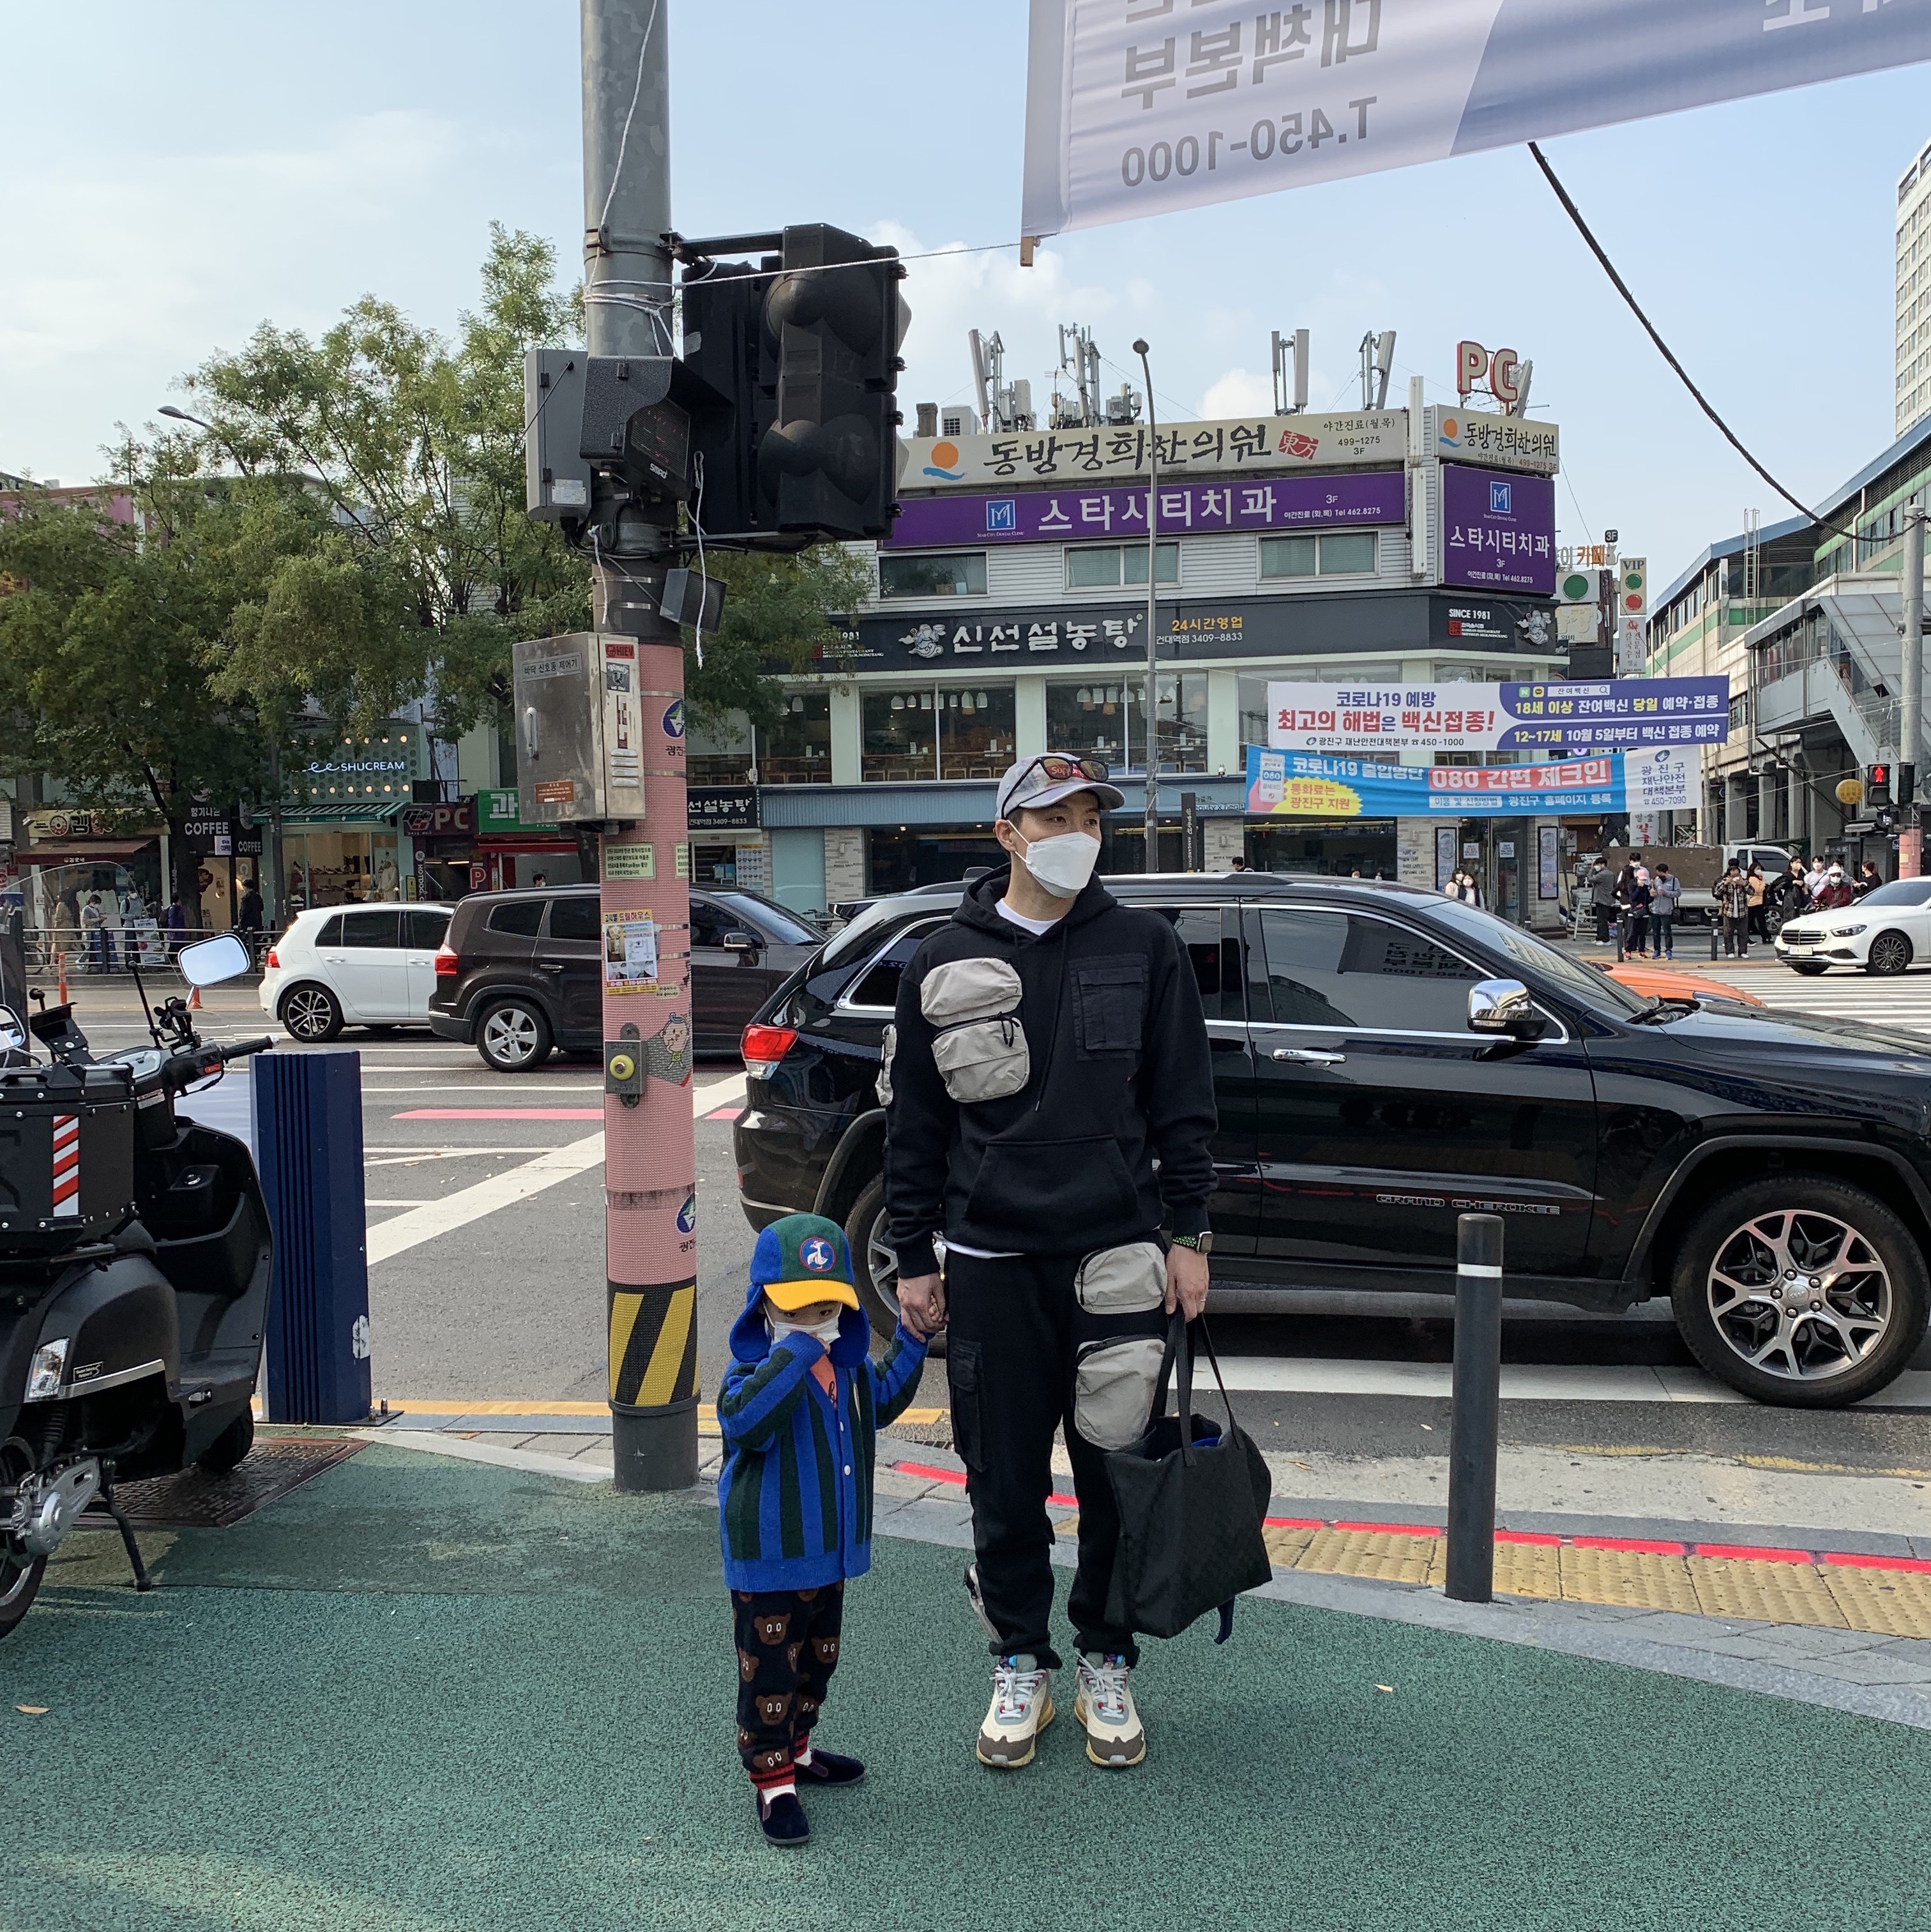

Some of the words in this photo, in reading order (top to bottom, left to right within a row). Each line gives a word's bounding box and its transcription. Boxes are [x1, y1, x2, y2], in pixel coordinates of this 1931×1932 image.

[1457, 340, 1518, 402] PC
[1338, 436, 1381, 446] 499-1275
[1464, 422, 1557, 459] 동방경희한의원
[984, 424, 1271, 476] 동방경희한의원
[1353, 447, 1365, 455] 3F
[1518, 459, 1547, 470] 499-1275
[1549, 462, 1557, 471] 3F
[1326, 494, 1338, 503] 3F
[1038, 486, 1276, 531] 스타시티치과
[1284, 511, 1310, 519] 야간진료
[1347, 507, 1381, 515] 462.8275
[1450, 526, 1550, 559] 스타시티치과
[1606, 531, 1617, 541] 3F
[1577, 545, 1605, 567] 카페
[1496, 558, 1505, 568] 3F
[1623, 560, 1644, 570] VIP
[1502, 574, 1510, 582] Tel
[1511, 575, 1533, 584] 462.8275
[1449, 609, 1471, 618] SINCE
[1473, 610, 1490, 620] 1981
[1172, 616, 1243, 632] 24시간영업
[953, 616, 1139, 653] 신선설농탕
[1156, 635, 1190, 645] 건대역점
[1192, 632, 1243, 643] 3409-8833
[524, 666, 536, 675] 바닥
[1558, 687, 1590, 695] 잔여백신
[1337, 692, 1401, 708] 코로나19
[1405, 692, 1437, 708] 예방
[1515, 701, 1543, 715] 18세
[1548, 701, 1573, 715] 이상
[1578, 699, 1629, 713] 잔여백신
[1633, 697, 1658, 711] 당일
[1278, 709, 1336, 732] 최고의
[1343, 710, 1397, 733] 해법은
[1401, 710, 1495, 733] 백신접종!
[1515, 729, 1562, 743] 12~17세
[1566, 729, 1593, 742] 10월
[1595, 727, 1638, 741] 5일부터
[1642, 726, 1665, 740] 백신
[1669, 724, 1692, 739] 접종
[1695, 723, 1720, 738] 예약
[1319, 737, 1342, 746] 광진구
[1345, 737, 1409, 747] 재난안전대책본부
[340, 761, 404, 772] SHUCREAM
[1292, 756, 1357, 777] 코로나19
[1432, 770, 1479, 789] 080
[1486, 769, 1532, 789] 간편
[1538, 759, 1607, 787] 체크인
[1263, 772, 1281, 780] 080
[1642, 774, 1686, 786] 재난안전
[1291, 783, 1336, 796] 통화료는
[1642, 785, 1686, 796] 대책본부
[1290, 797, 1324, 809] 광진구
[1328, 797, 1350, 810] 지원
[1435, 798, 1451, 807] 이용
[1508, 796, 1540, 807] 광진구
[1544, 794, 1586, 806] 홈페이지
[1590, 793, 1612, 804] 등록
[1651, 795, 1687, 805] 450-7090
[434, 807, 469, 830] PC
[185, 821, 229, 835] COFFEE
[238, 840, 261, 853] COFFEE
[619, 911, 650, 922] 드림하우스
[1376, 1194, 1445, 1208] GRAND
[1451, 1199, 1560, 1215] CHEROKEE
